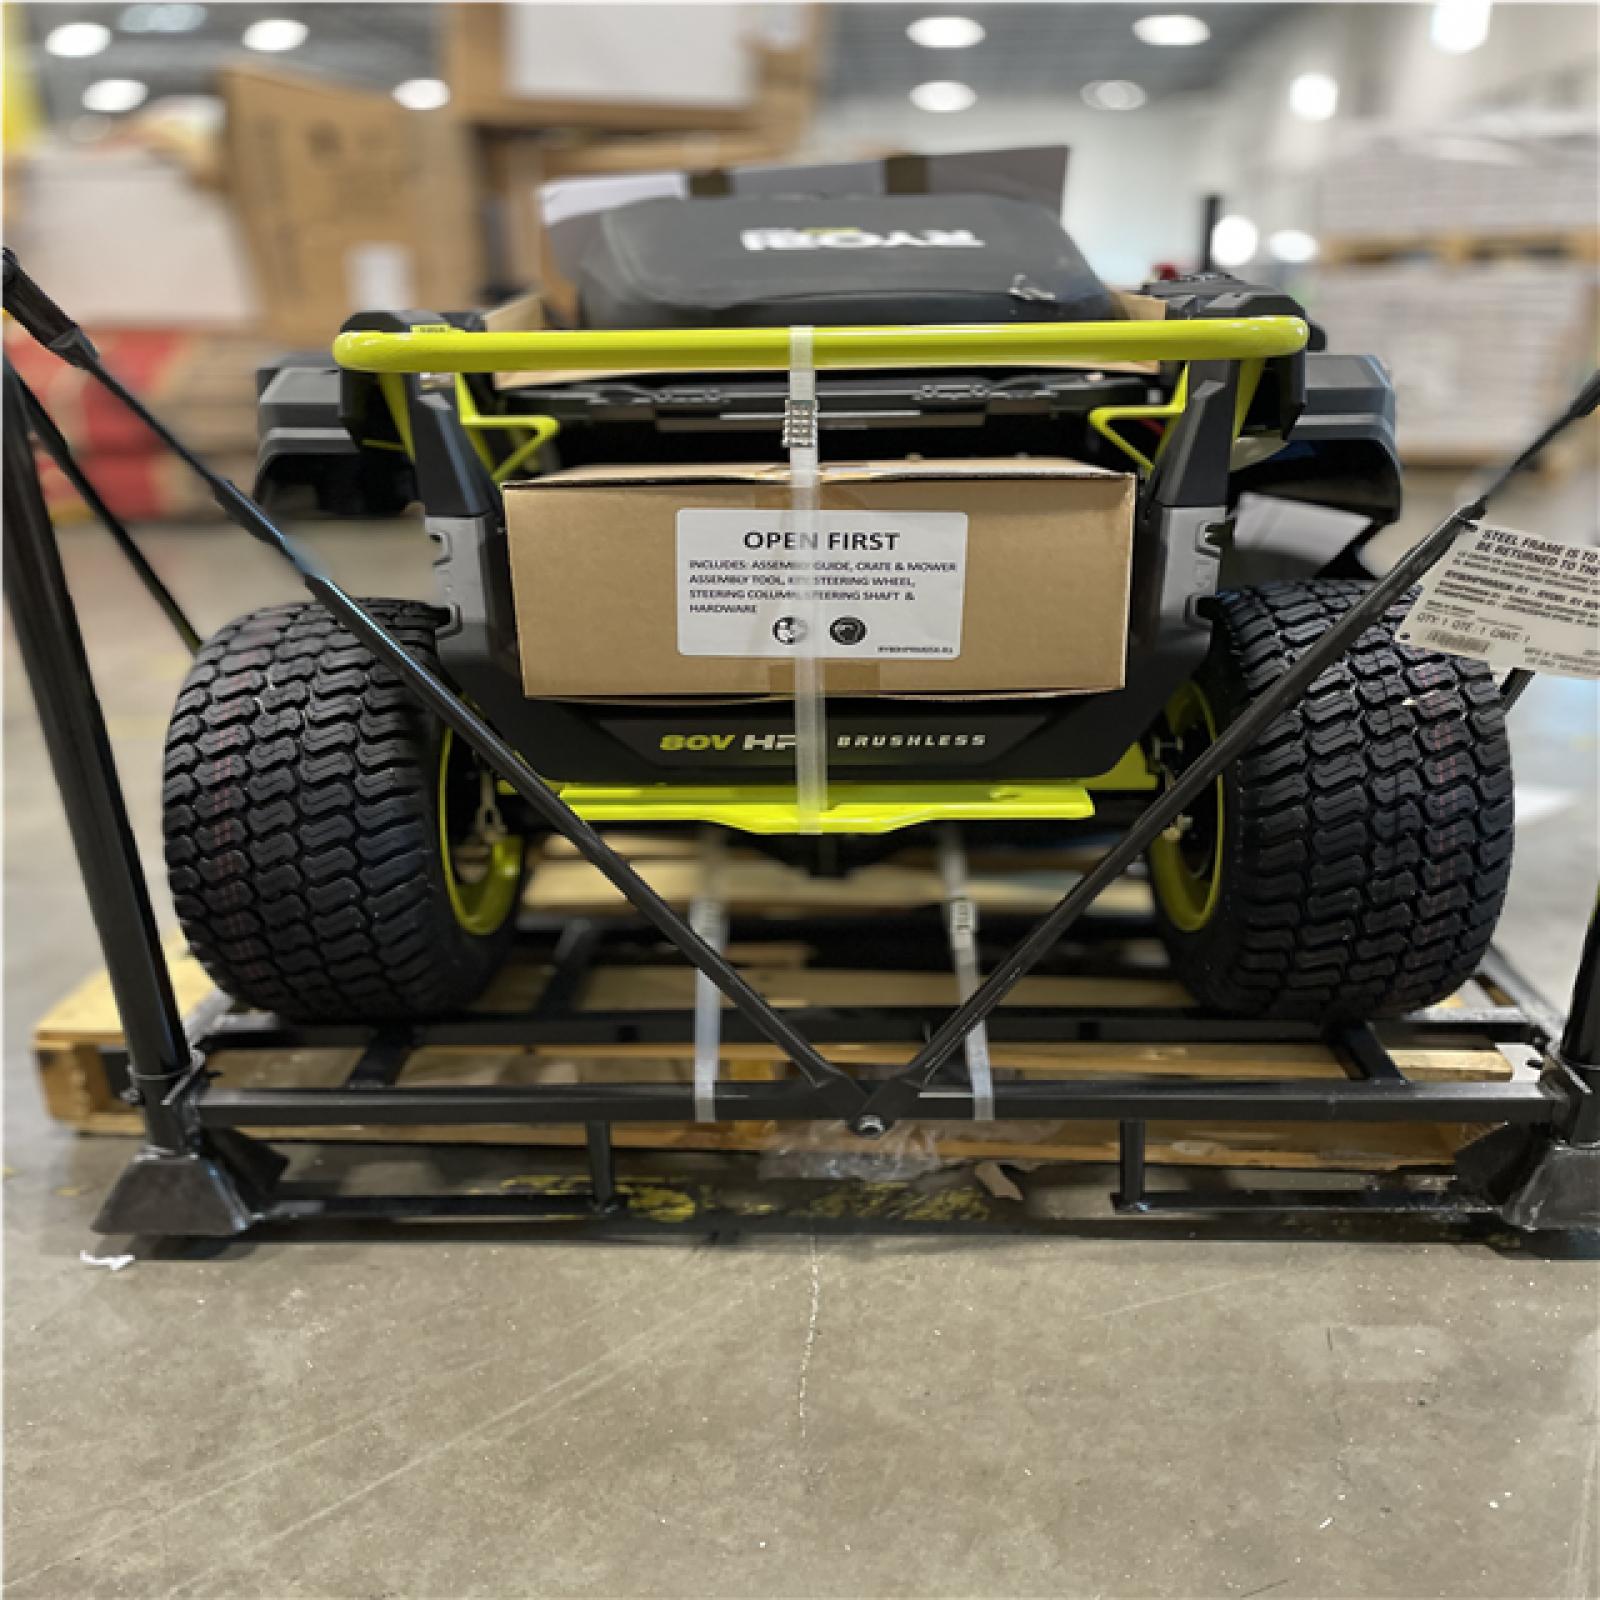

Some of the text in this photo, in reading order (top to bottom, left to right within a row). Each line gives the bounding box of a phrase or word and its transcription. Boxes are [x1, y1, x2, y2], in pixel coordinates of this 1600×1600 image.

[743, 531, 901, 551] OPEN FIRST
[1483, 529, 1518, 546] STEEL
[1521, 536, 1565, 556] FRAME
[1565, 549, 1580, 559] IS
[1475, 541, 1492, 553] BE
[1495, 544, 1558, 567] RETURNED
[1560, 559, 1577, 571] TO
[689, 560, 746, 570] INCLUDES:
[813, 561, 853, 573] GUIDE,
[855, 562, 891, 572] CRATE
[894, 562, 905, 572] &
[907, 562, 957, 573] MOWER
[689, 575, 749, 585] ASSEMBLY
[752, 575, 785, 587] TOOL,
[812, 576, 868, 587] STEERING
[872, 576, 916, 588] WHEEL,
[689, 589, 745, 600] STEERING
[863, 591, 900, 601] SHAFT
[904, 591, 916, 601] &
[689, 604, 757, 614] HARDWARE
[659, 734, 736, 751] 80V
[837, 734, 987, 748] BRUSHLESS
